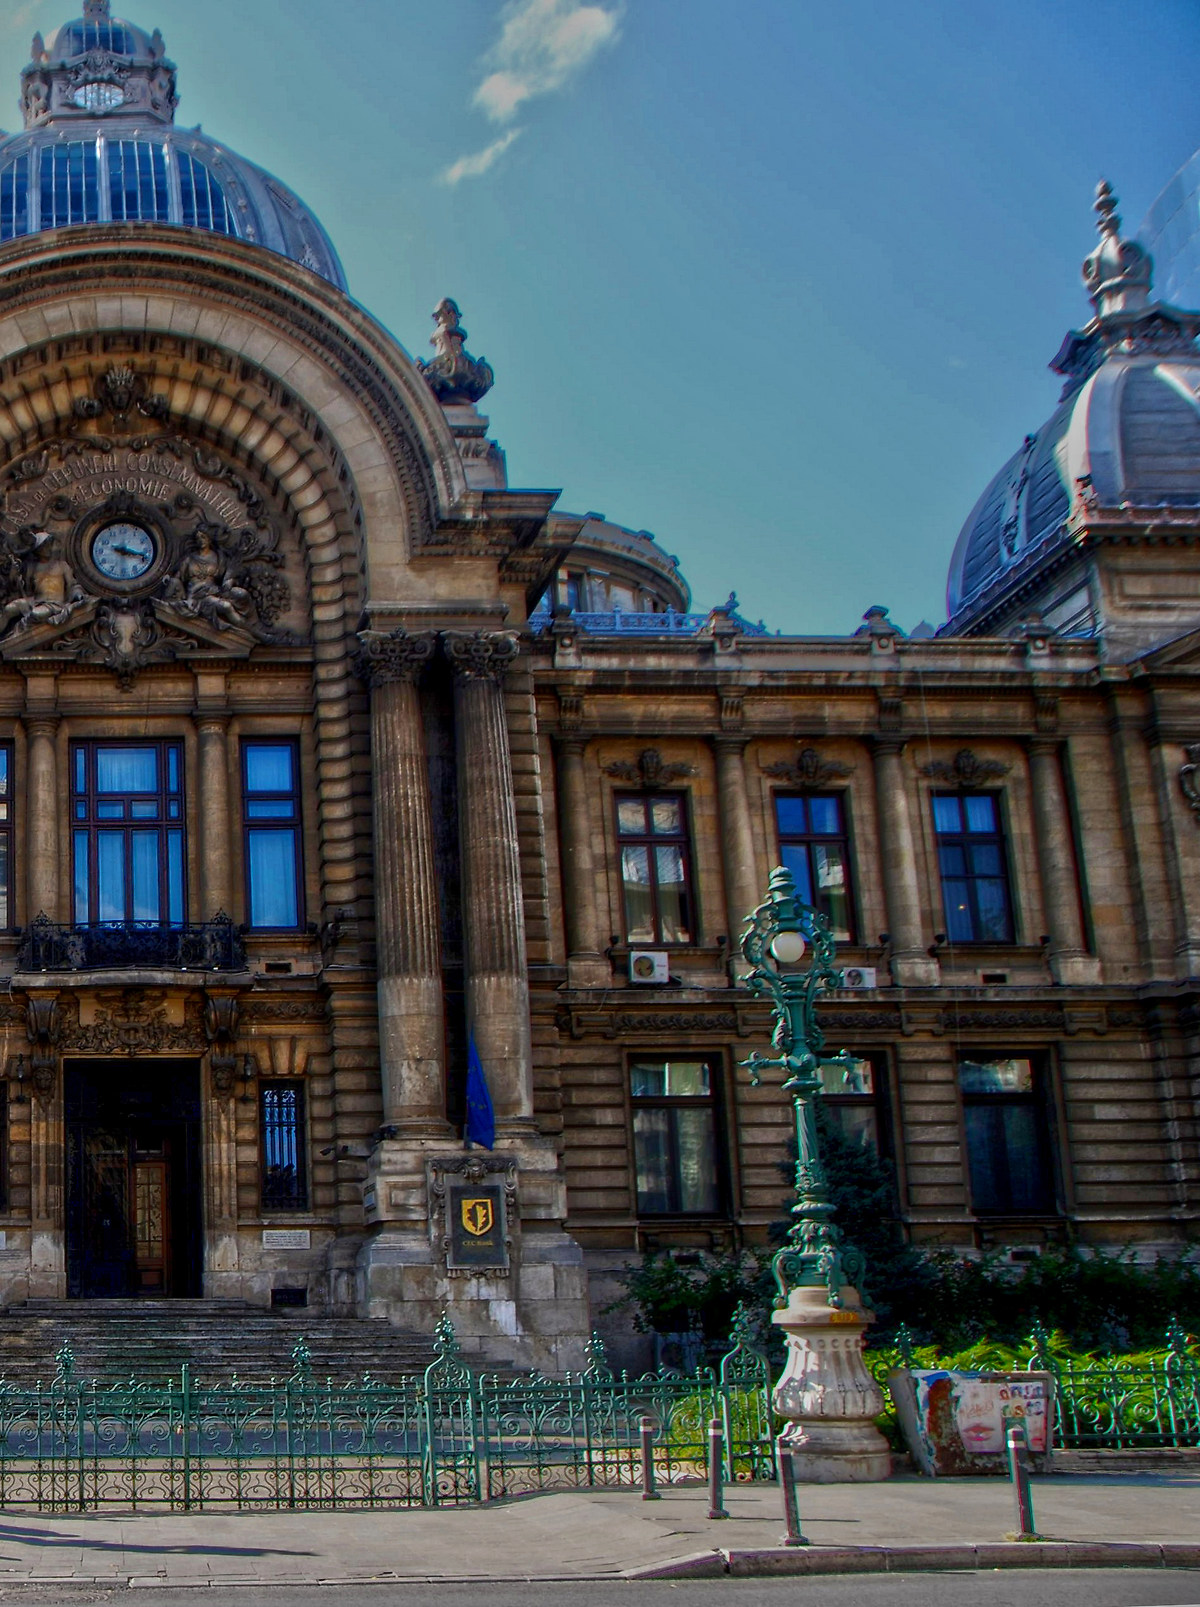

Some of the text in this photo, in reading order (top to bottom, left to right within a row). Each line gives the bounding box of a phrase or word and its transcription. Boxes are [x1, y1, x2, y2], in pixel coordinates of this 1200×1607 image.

[1, 501, 35, 535] CASA
[41, 454, 118, 492] DEPUNERI
[79, 477, 169, 500] ECONOMIE
